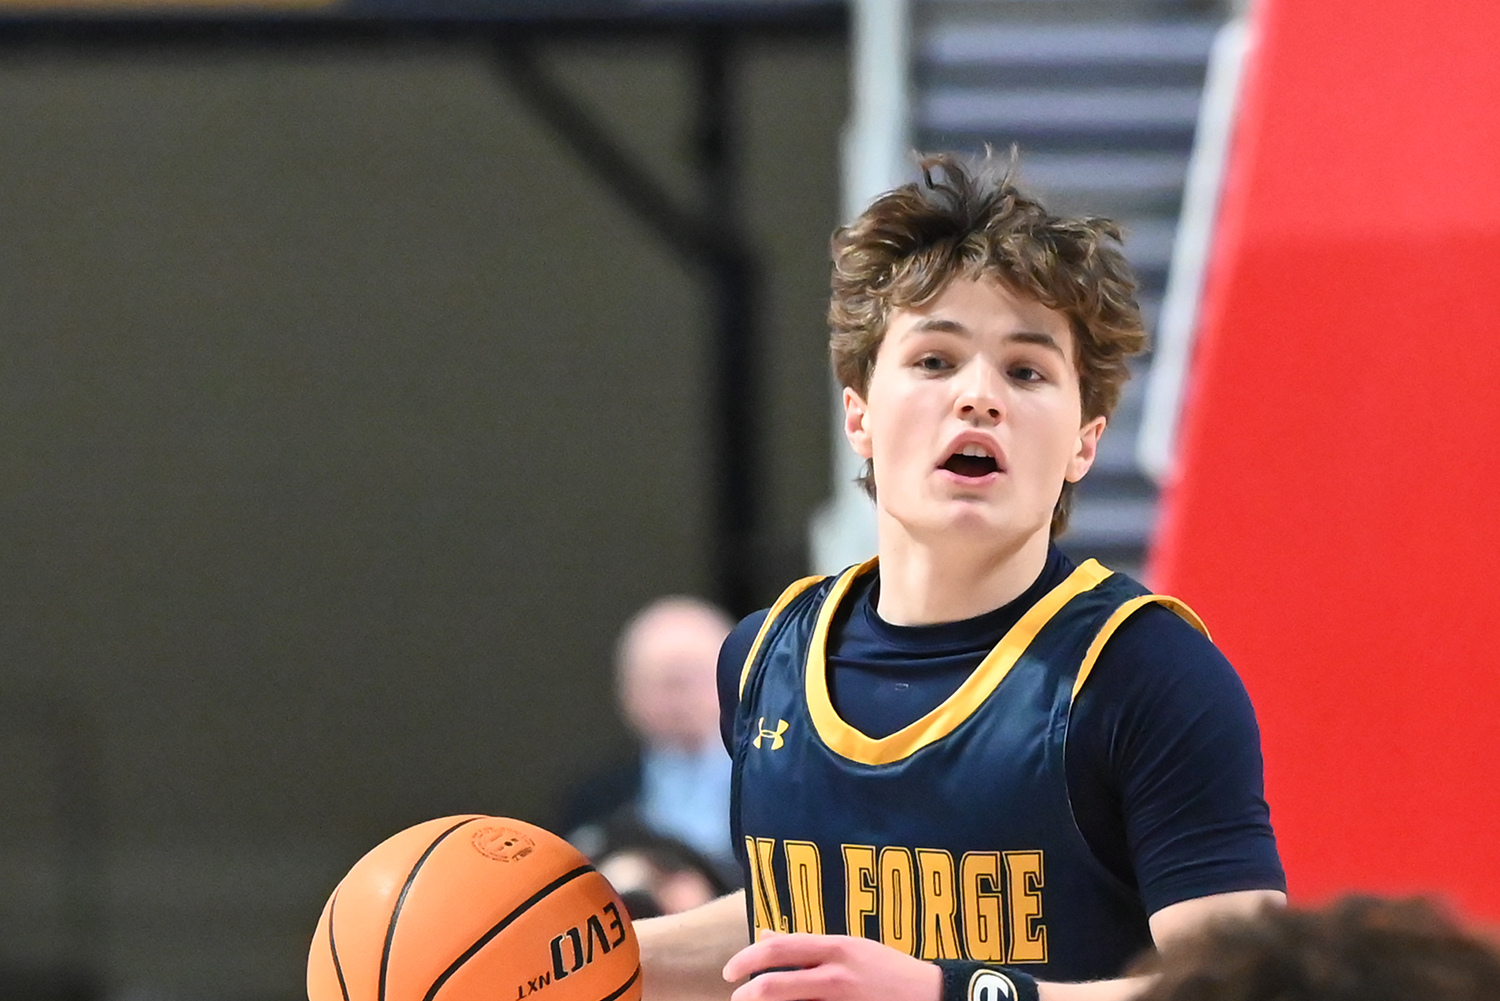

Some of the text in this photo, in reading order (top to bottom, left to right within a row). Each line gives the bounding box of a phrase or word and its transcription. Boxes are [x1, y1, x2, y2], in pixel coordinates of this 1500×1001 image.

[745, 835, 1048, 964] LD FORGE
[515, 970, 551, 1001] NXT
